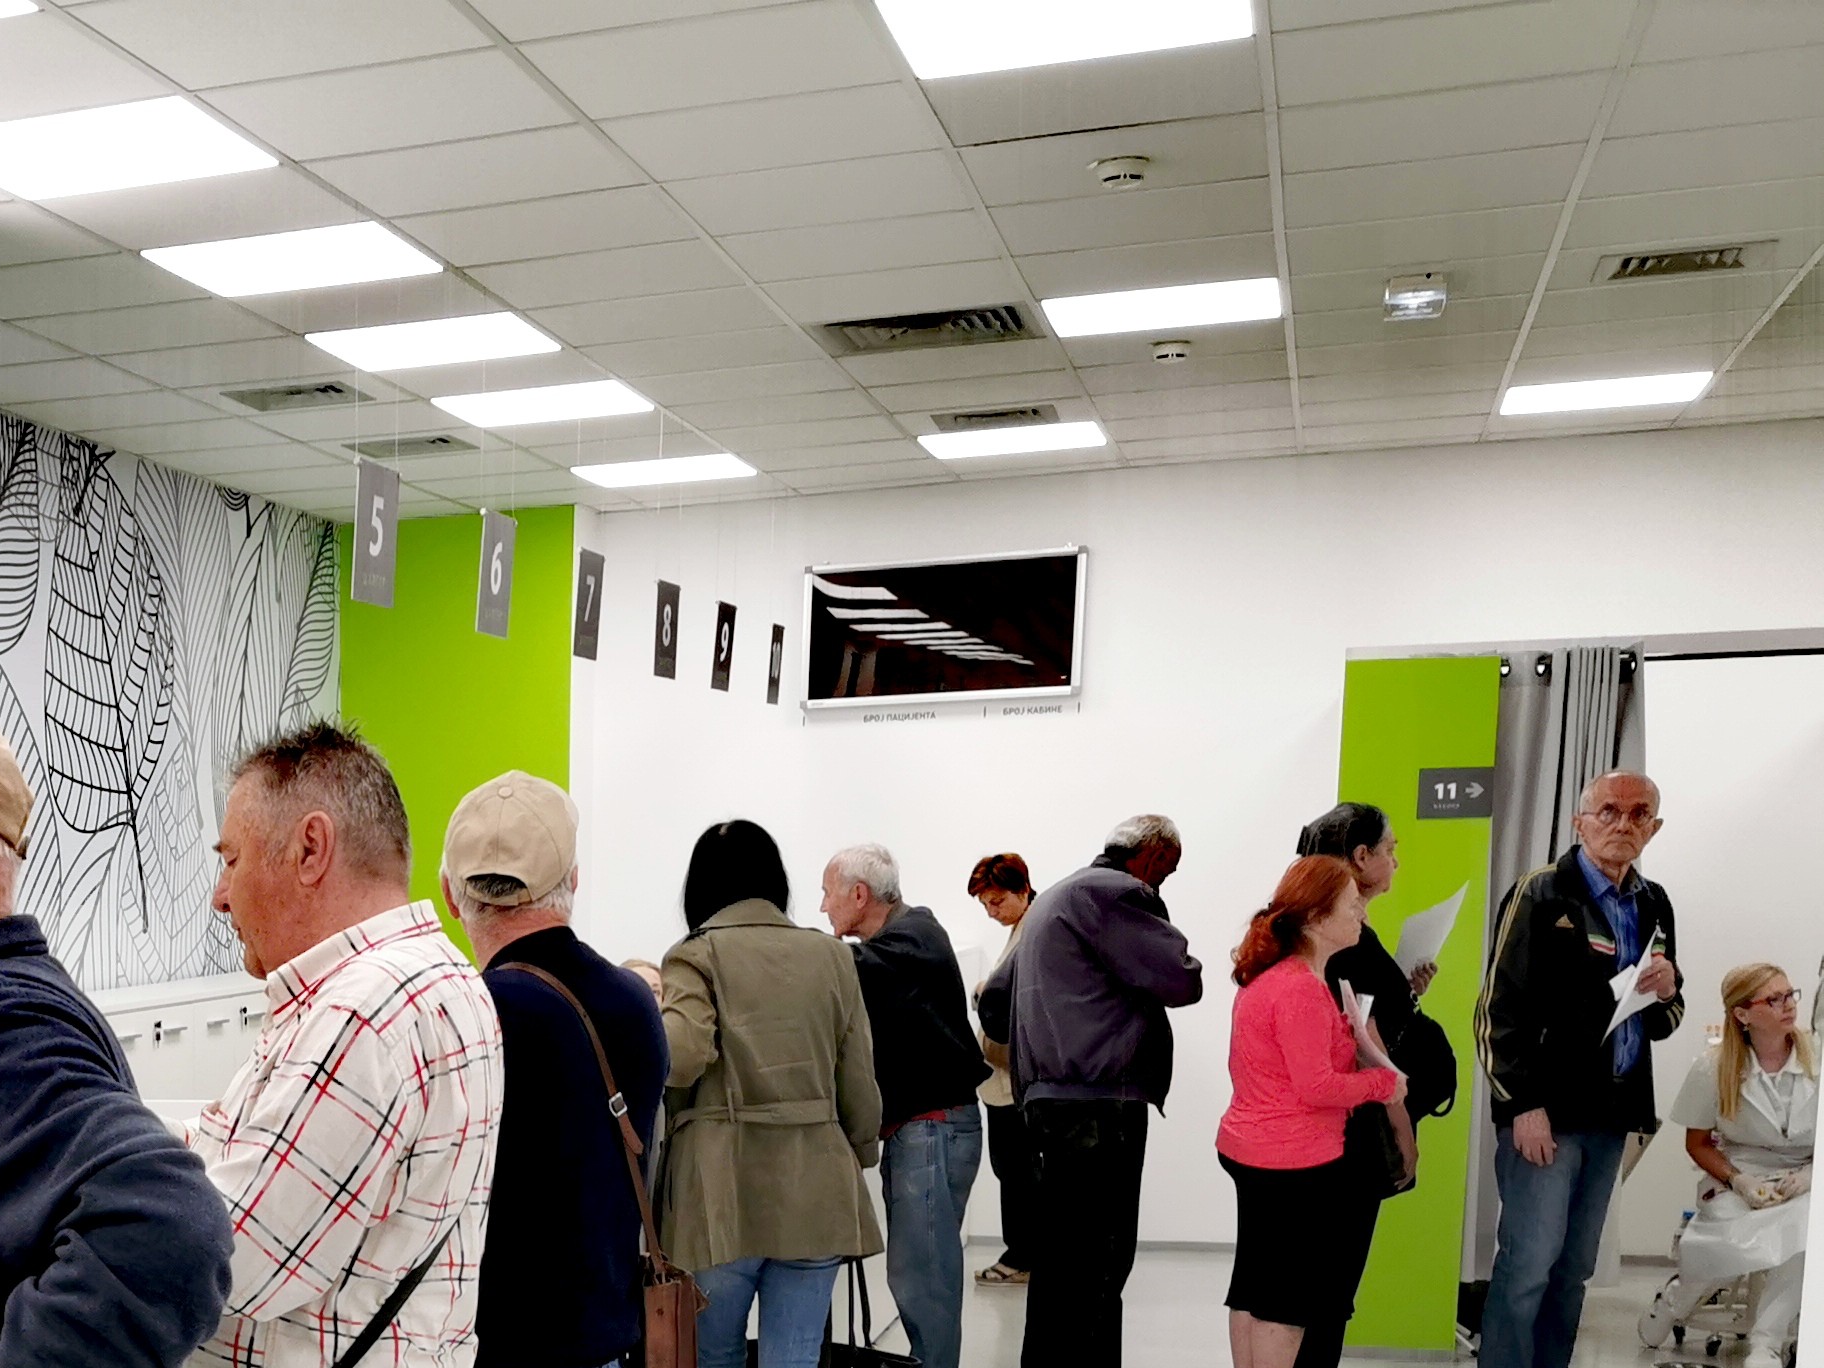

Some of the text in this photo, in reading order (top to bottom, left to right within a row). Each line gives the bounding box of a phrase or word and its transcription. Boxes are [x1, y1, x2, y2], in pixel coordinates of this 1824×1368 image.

[369, 494, 385, 557] 5
[490, 541, 503, 595] 6
[584, 574, 596, 622] 7
[662, 603, 672, 647] 8
[719, 621, 729, 662] 9
[863, 714, 885, 723] БРОЈ
[1002, 706, 1025, 716] БРОЈ
[1434, 782, 1457, 800] 11
